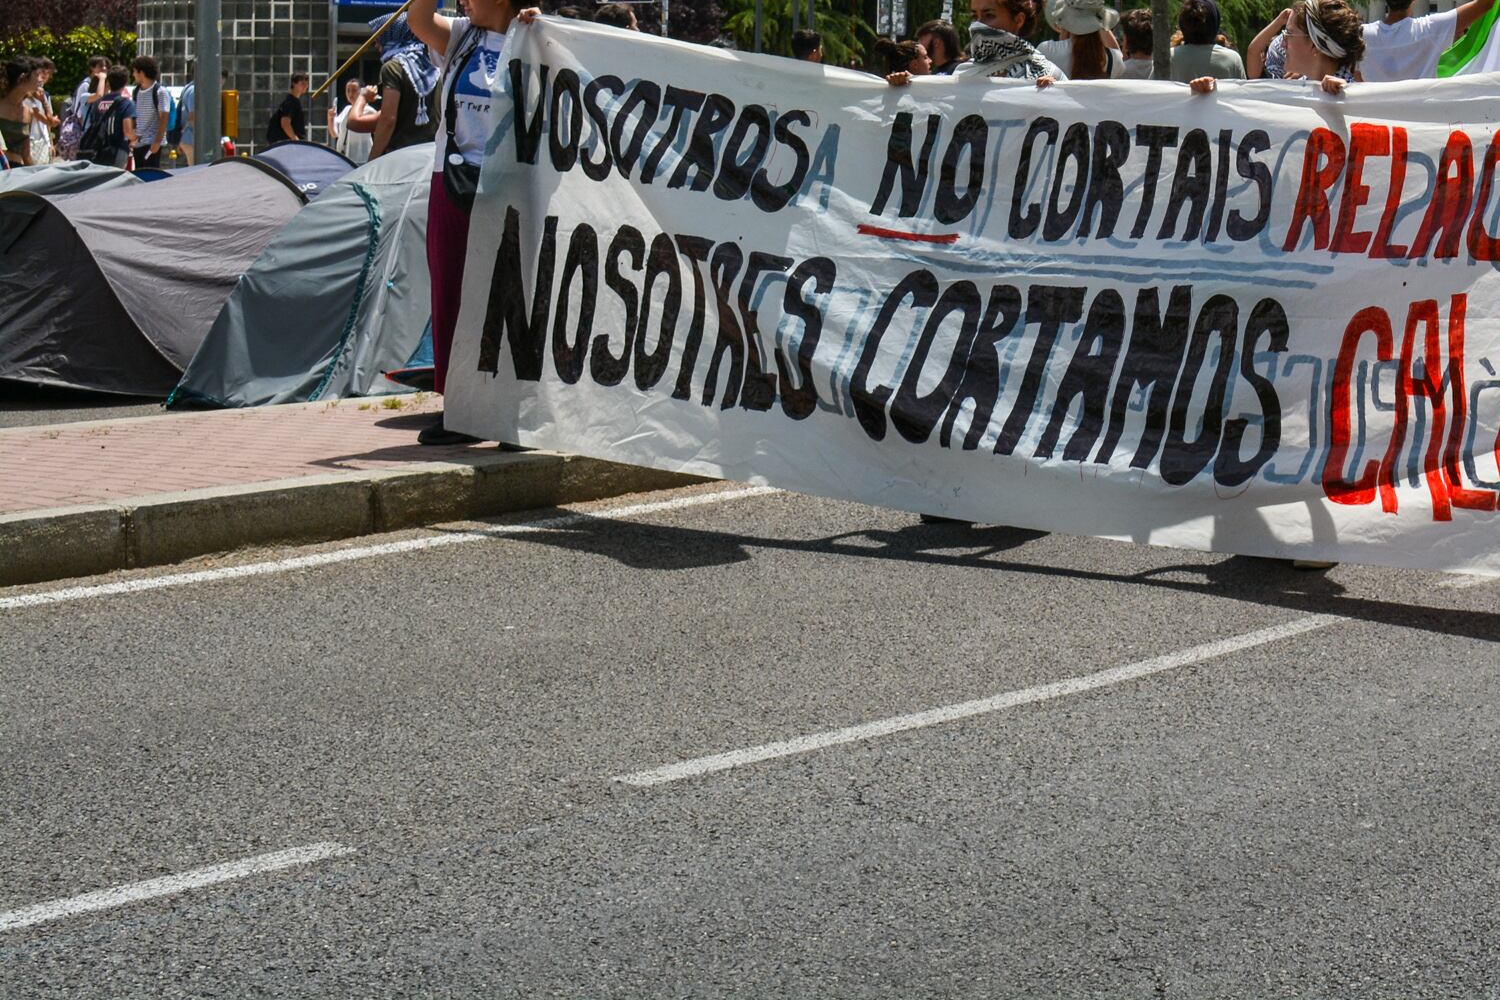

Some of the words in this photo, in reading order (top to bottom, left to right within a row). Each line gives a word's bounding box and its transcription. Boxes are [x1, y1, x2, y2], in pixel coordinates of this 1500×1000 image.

[509, 58, 811, 212] VOSOTROS
[870, 112, 987, 225] NO
[1008, 116, 1272, 242] CORTAIS
[478, 204, 837, 420] NOSOTRES
[849, 269, 1289, 487] CORTAMOS
